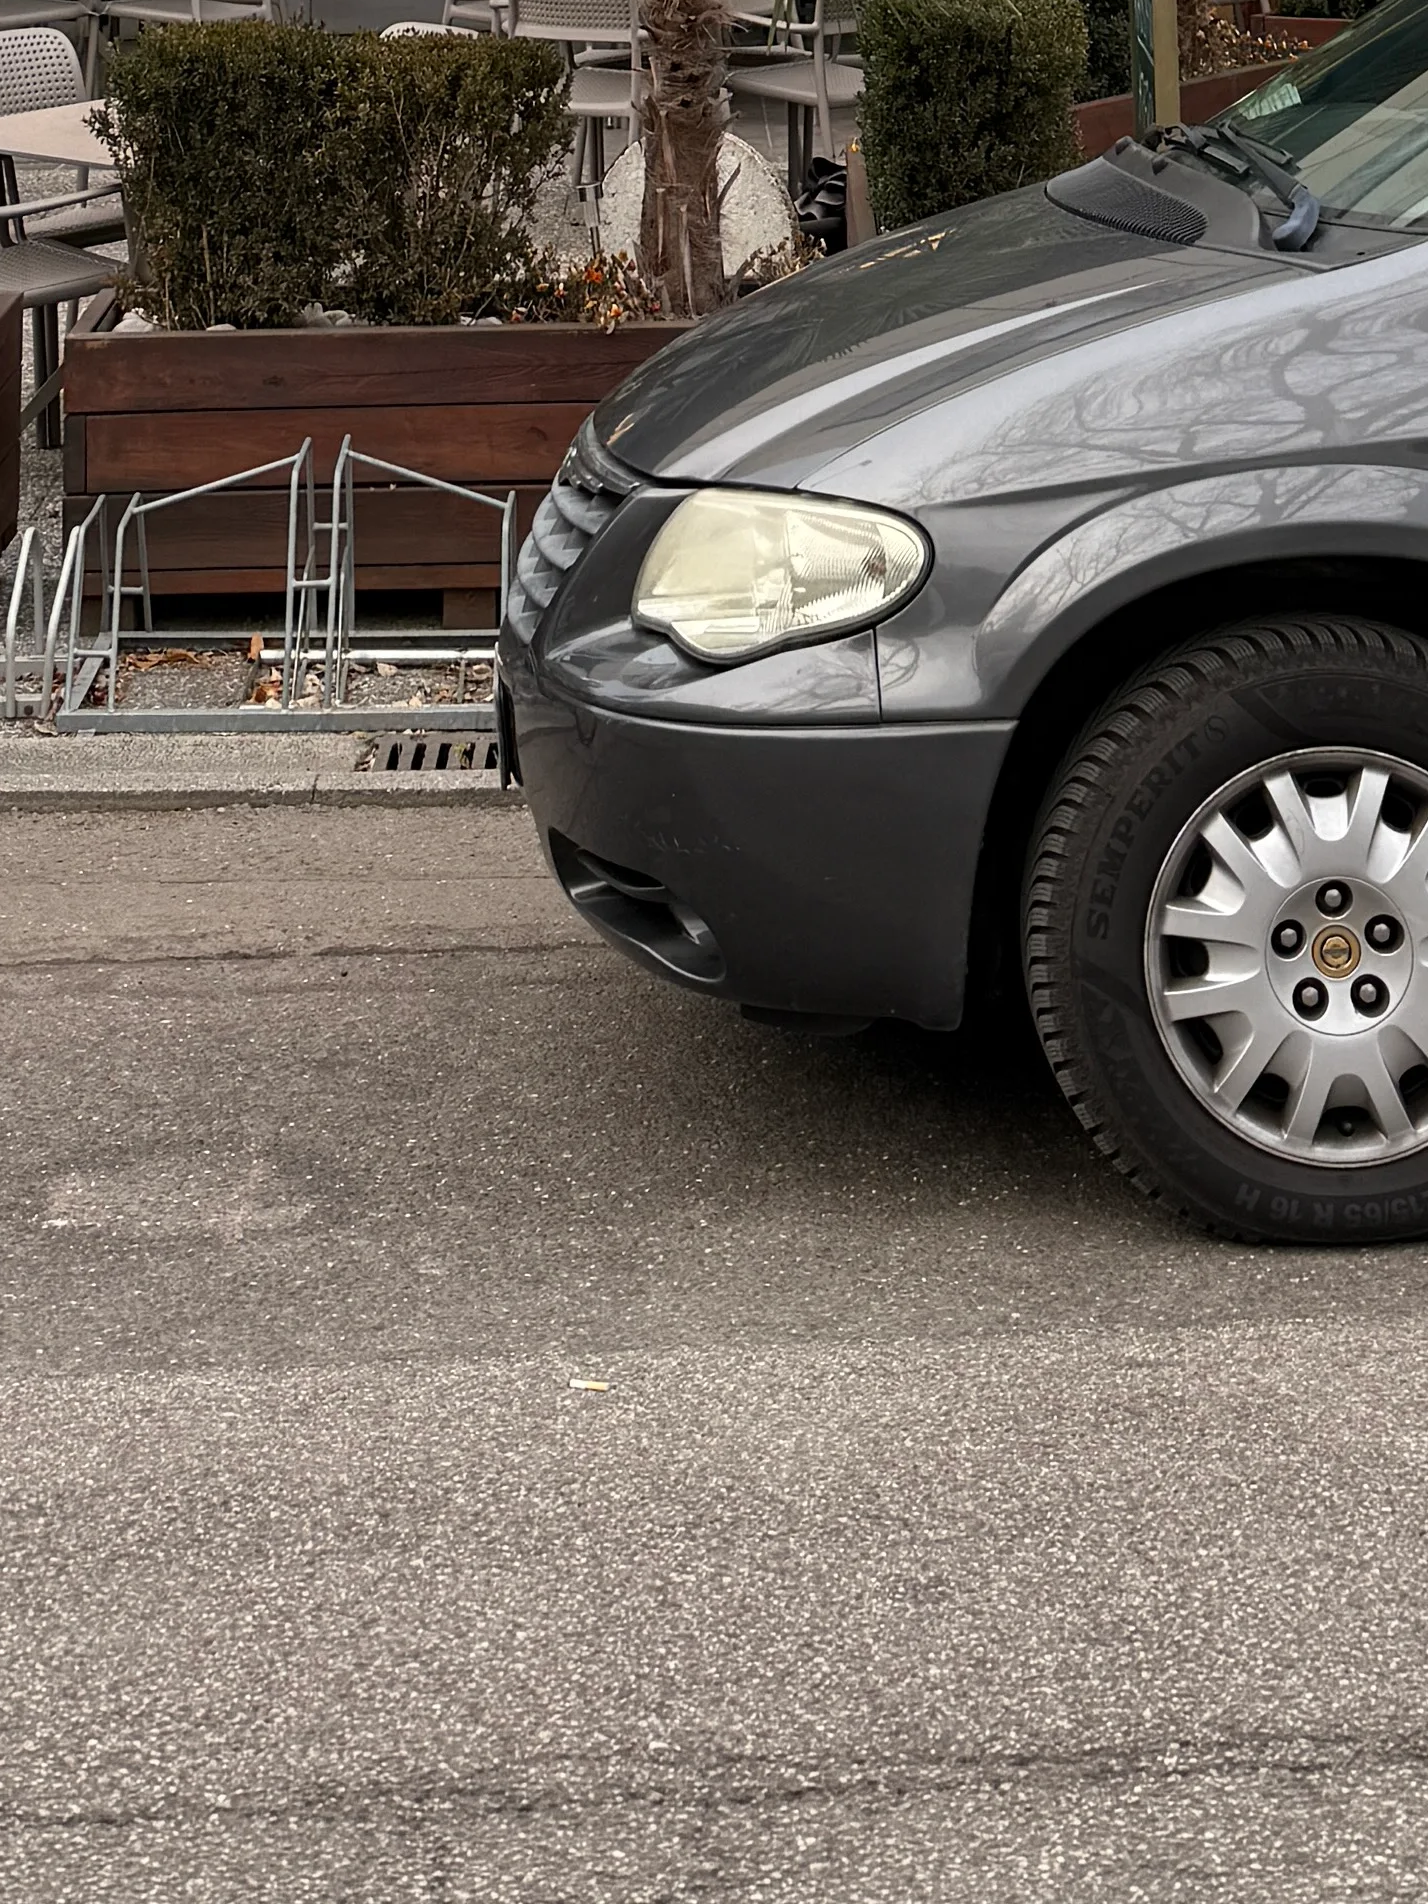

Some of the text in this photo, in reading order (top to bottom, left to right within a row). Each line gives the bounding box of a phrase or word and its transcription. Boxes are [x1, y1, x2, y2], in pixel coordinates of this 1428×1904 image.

[1085, 731, 1201, 941] SEMPERIT
[1270, 1195, 1302, 1223] 16
[1312, 1200, 1335, 1228] R
